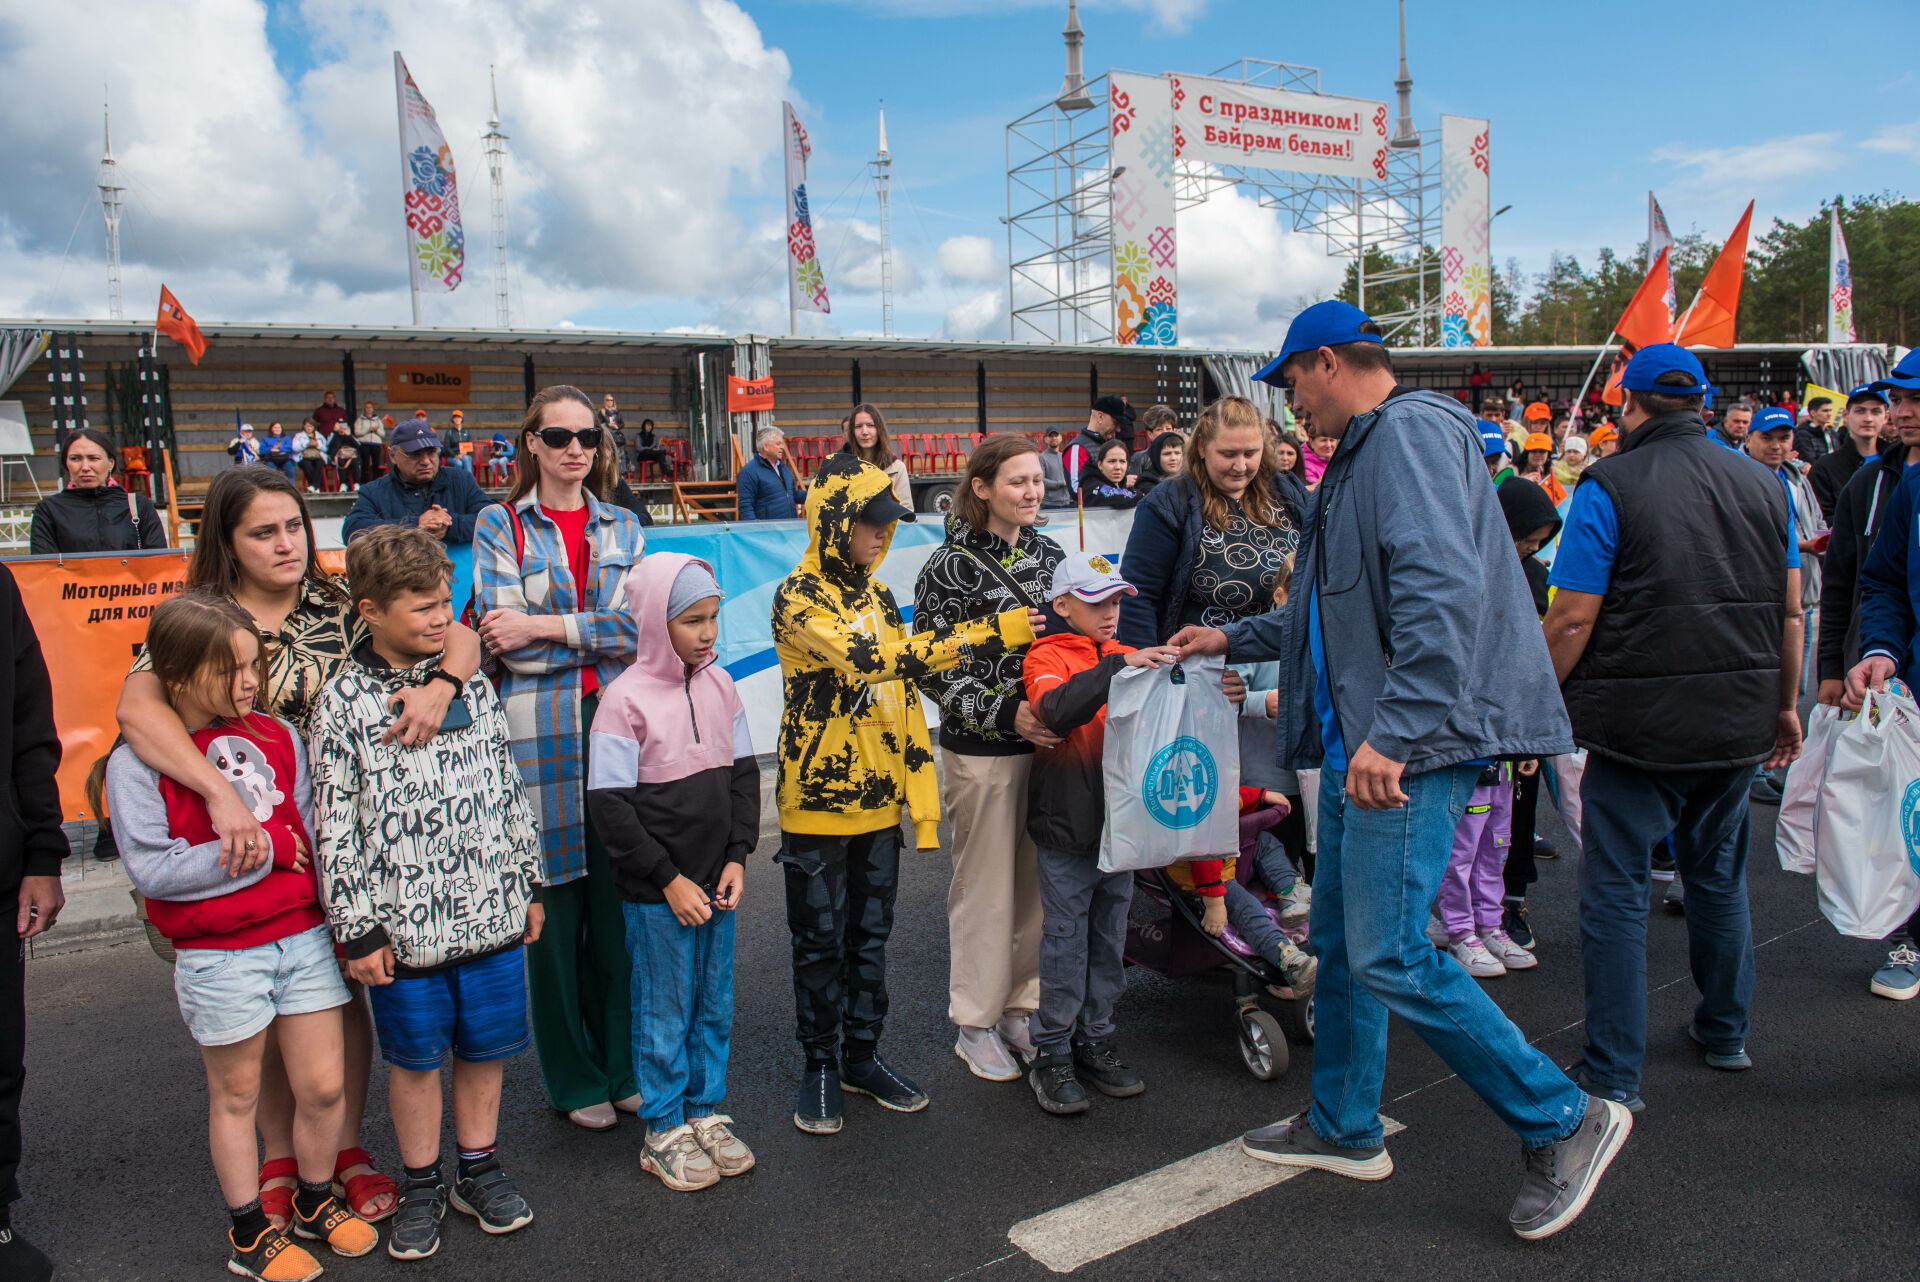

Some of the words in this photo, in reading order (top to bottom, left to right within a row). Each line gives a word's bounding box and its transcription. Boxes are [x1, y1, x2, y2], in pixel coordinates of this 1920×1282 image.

[1200, 95, 1212, 114] С
[1220, 101, 1360, 132] праздником!
[1204, 125, 1281, 152] Бәйрәм
[1288, 133, 1352, 158] белән!
[411, 372, 462, 386] Delko
[62, 580, 157, 601] Моторные
[161, 580, 185, 595] ма
[88, 607, 123, 624] для
[373, 775, 445, 814] URBAN
[381, 790, 487, 846] CUSTOM
[448, 905, 520, 943] STREET
